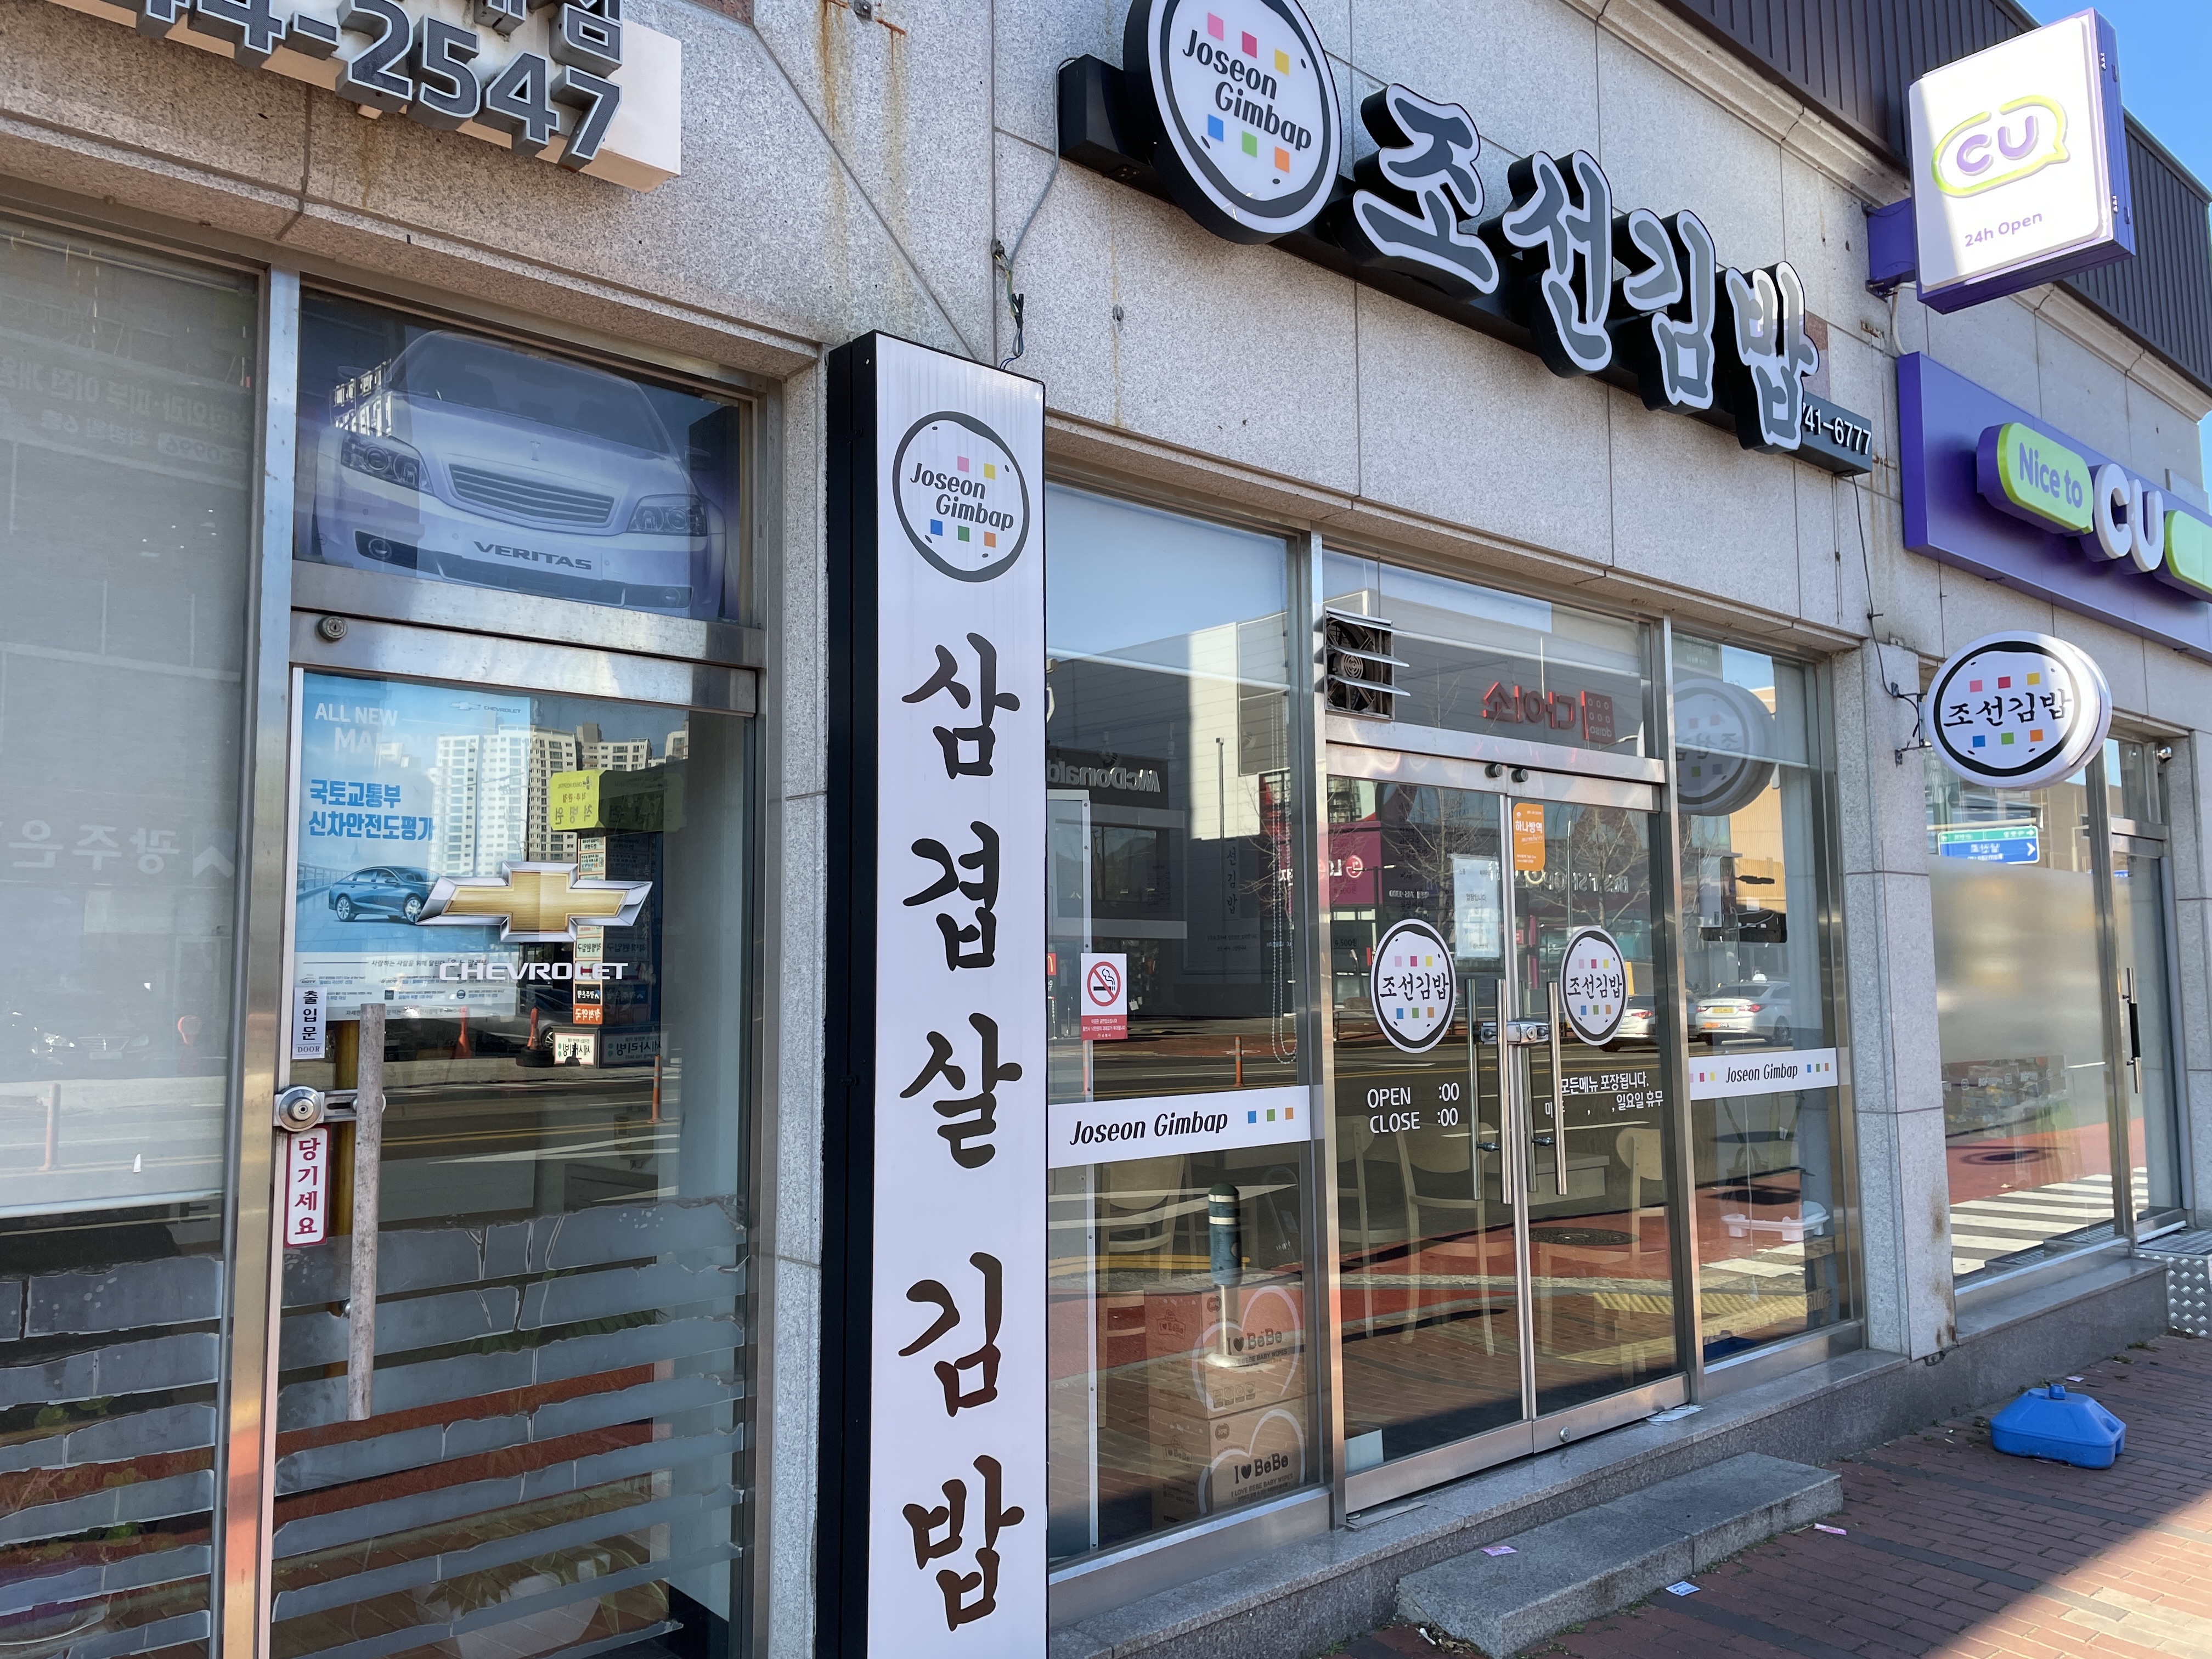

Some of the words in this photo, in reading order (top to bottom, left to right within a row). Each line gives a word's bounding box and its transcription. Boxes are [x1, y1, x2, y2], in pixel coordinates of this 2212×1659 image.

[1182, 30, 1278, 100] Joseon
[1214, 81, 1312, 152] Gimbap
[1956, 115, 2039, 176] CU
[1965, 227, 1994, 247] 24h
[1999, 212, 2042, 237] Open
[1353, 82, 1819, 451] 조선김밥
[909, 462, 986, 500] Joseon
[935, 484, 1015, 533] Gimbap
[2019, 442, 2060, 499] Nice
[2063, 469, 2083, 509] to
[2093, 462, 2165, 573] CU
[473, 540, 592, 571] VERITAS
[314, 702, 351, 724] ALL
[355, 706, 399, 729] NEW
[483, 705, 521, 713] CHEVROLET
[1943, 688, 2072, 727] 조선김밥
[309, 778, 402, 809] 국토교통부
[308, 810, 433, 842] 신차안전도평가
[1515, 820, 1543, 834] 하나방역
[900, 632, 1023, 1170] 삼겹살
[439, 962, 629, 981] CHEVROLET
[1379, 972, 1449, 1001] 조선김밥
[1567, 973, 1623, 999] 조선김밥
[302, 990, 319, 1041] 출입문
[1561, 1076, 1599, 1094] 모든메뉴
[1600, 1071, 1650, 1091] 포장됩니다.
[1725, 1066, 1760, 1084] Joseon
[1763, 1063, 1798, 1080] Gimbap
[1367, 1086, 1412, 1109] OPEN
[1438, 1082, 1460, 1102] :00
[1616, 1092, 1644, 1111] 일요일
[1646, 1090, 1664, 1108] 휴무
[1069, 1120, 1146, 1146] Joseon
[1154, 1110, 1228, 1137] Gimbap
[1369, 1111, 1421, 1134] CLOSE
[1437, 1107, 1459, 1127] :00
[294, 1138, 321, 1236] 당기세요
[1271, 1348, 1288, 1358] WIPES
[898, 1251, 1025, 1632] 김밥
[1234, 1486, 1248, 1497] LOVE
[1249, 1482, 1262, 1493] BEBE
[1263, 1479, 1277, 1489] BABY
[1278, 1472, 1294, 1484] WIPES
